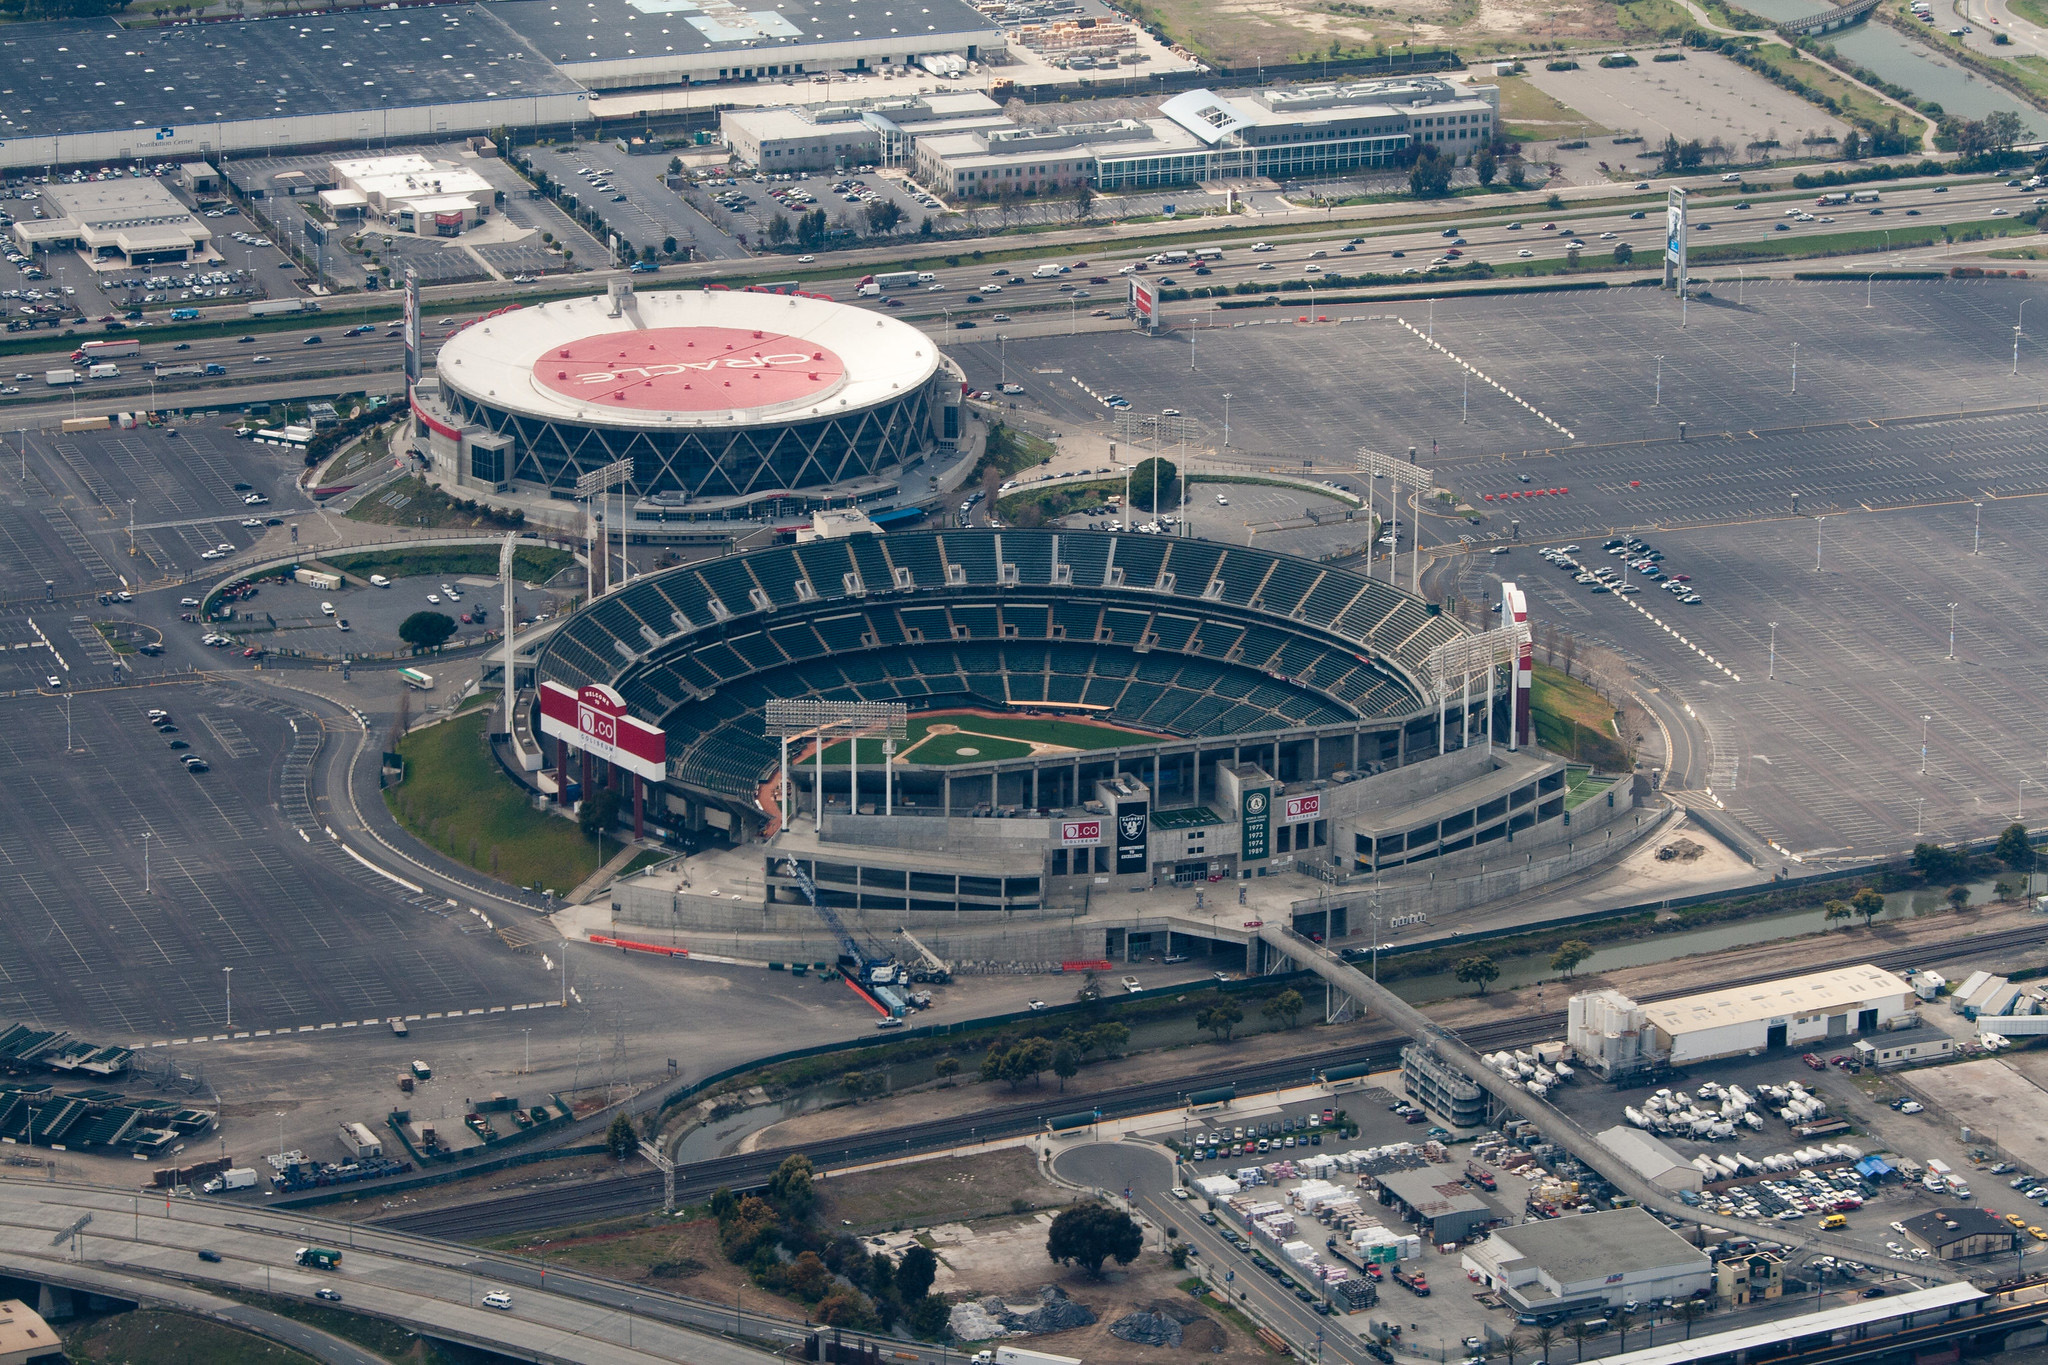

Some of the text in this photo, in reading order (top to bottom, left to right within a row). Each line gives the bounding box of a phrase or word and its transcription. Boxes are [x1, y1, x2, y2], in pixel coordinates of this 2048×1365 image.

[575, 353, 811, 385] ORACLE
[584, 691, 610, 706] WELCOME
[581, 734, 613, 752] COLISEUM
